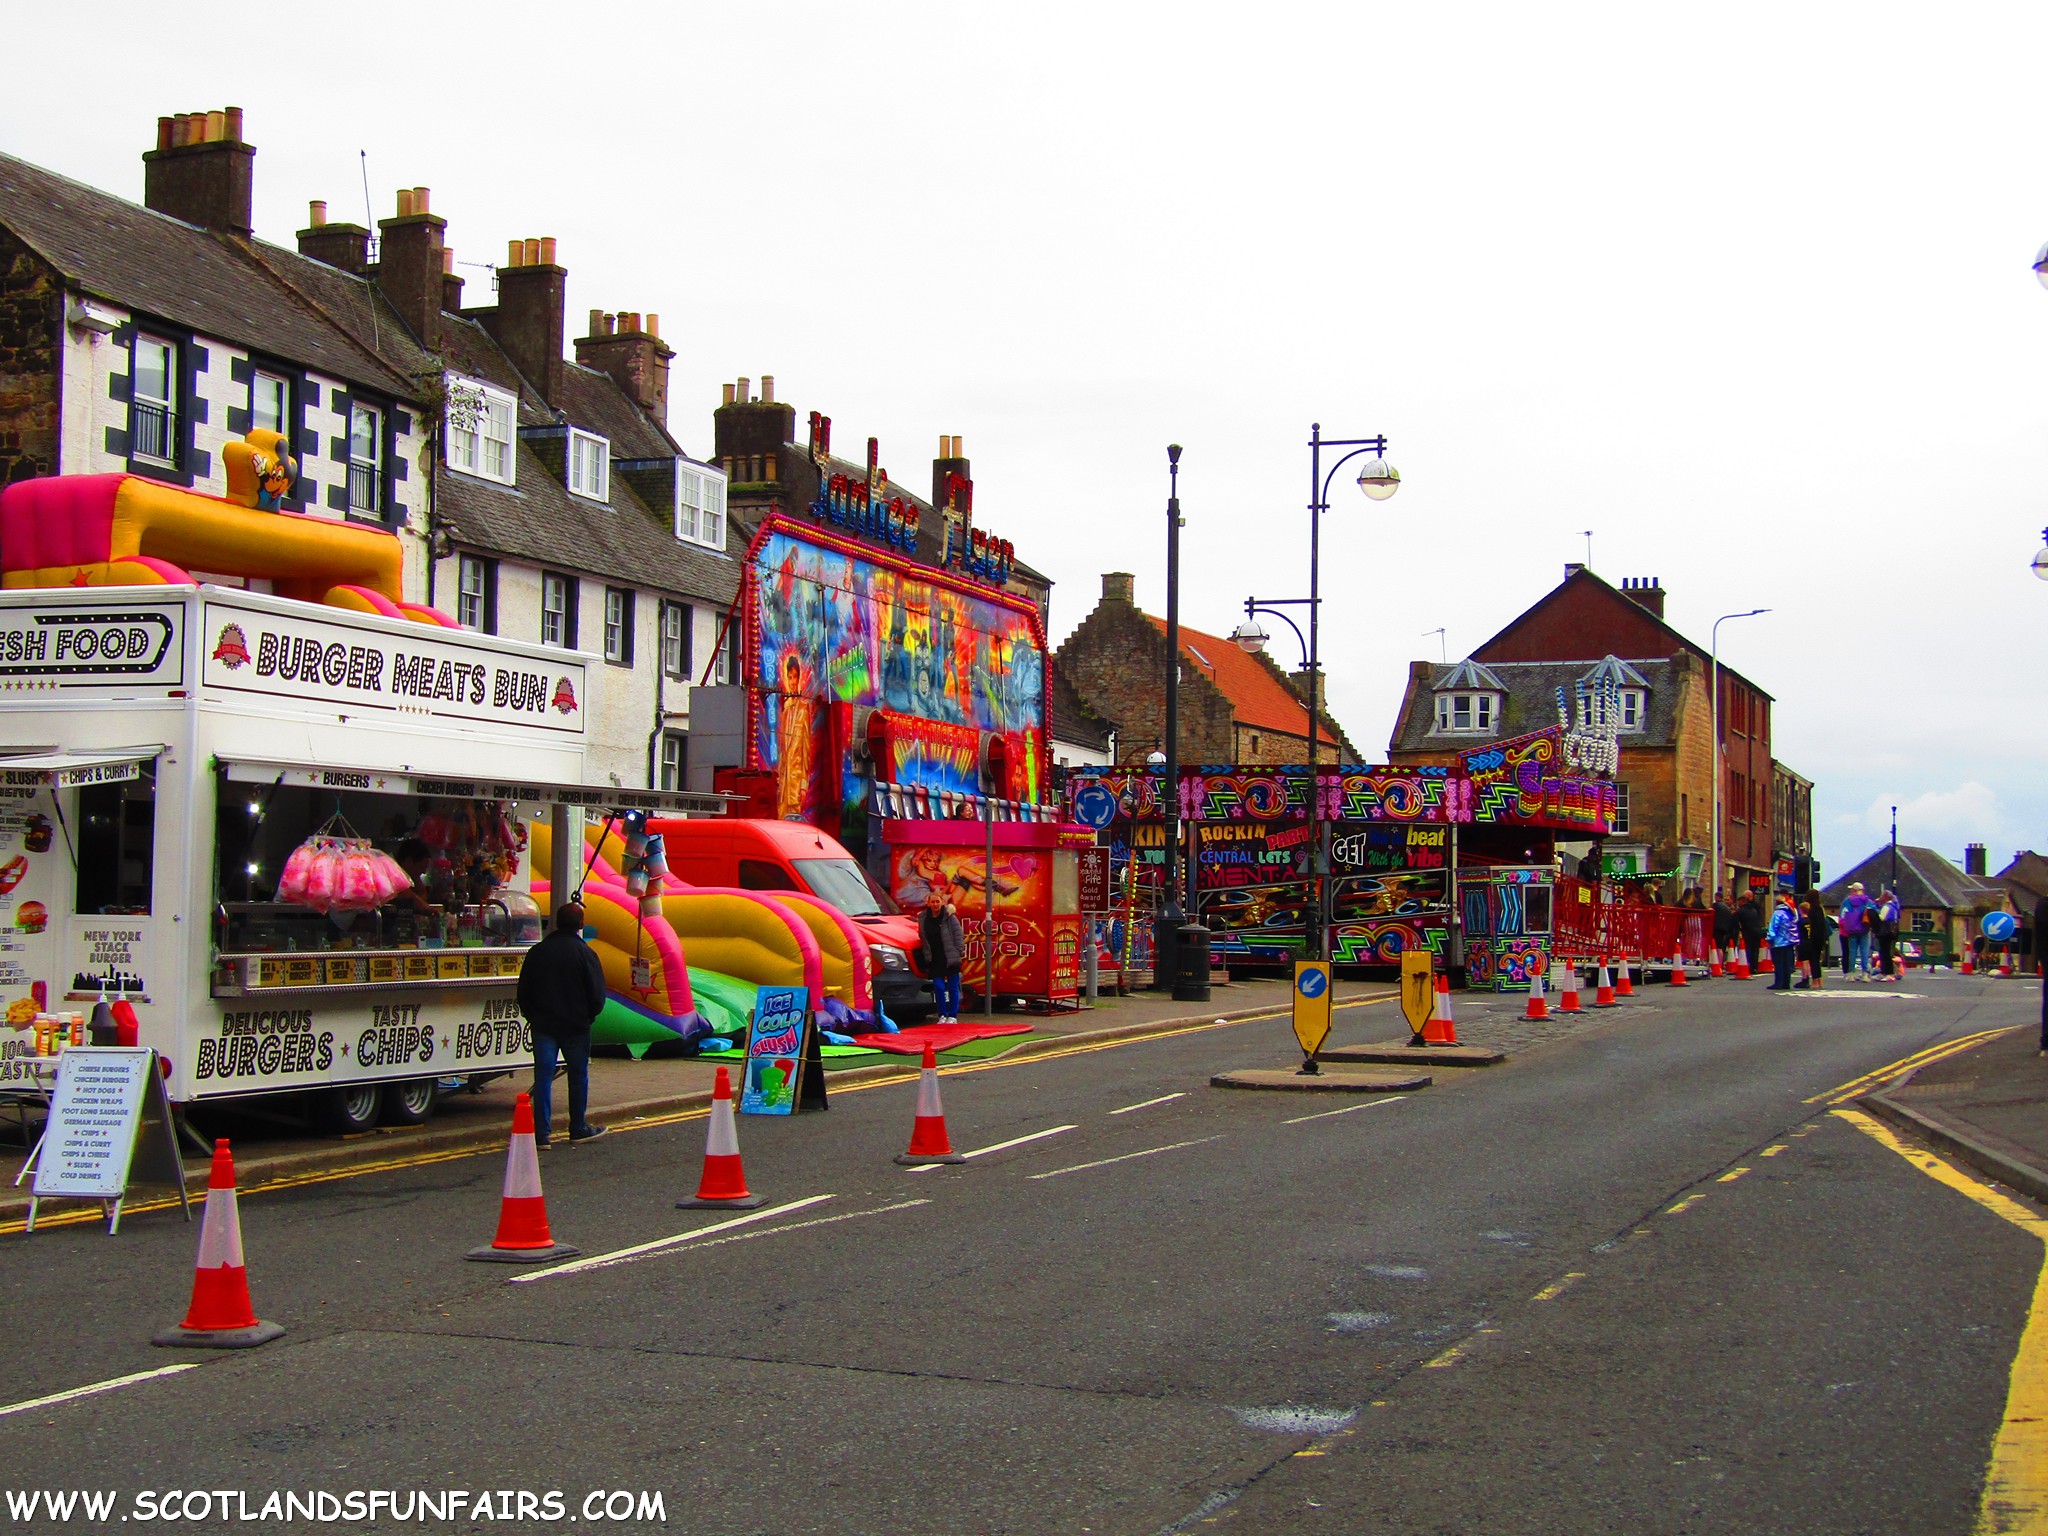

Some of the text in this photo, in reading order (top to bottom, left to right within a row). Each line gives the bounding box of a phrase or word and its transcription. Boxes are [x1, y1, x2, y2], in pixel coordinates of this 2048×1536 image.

[809, 411, 1014, 584] Yankee Flyer
[56, 628, 149, 660] FOOD
[256, 631, 548, 713] BURGER MEATS BUN
[6, 770, 39, 785] SLUSH
[70, 764, 129, 784] CHIPS & CURRY
[323, 771, 370, 788] BURGERS
[416, 780, 475, 797] CHICKEN BURGERS
[493, 785, 511, 799] CHIPS
[1458, 779, 1471, 822] SPIN
[1199, 824, 1266, 842] ROCKIN
[1406, 824, 1445, 846] beat
[1199, 850, 1254, 863] CENTRAL
[1258, 850, 1291, 864] LETS
[1332, 833, 1367, 866] GET
[1407, 846, 1443, 867] vibe
[1082, 886, 1098, 894] Gold
[1750, 875, 1770, 887] CAFE
[84, 930, 142, 942] NEW YORK
[961, 917, 1019, 937] kee
[94, 941, 129, 953] STACK
[89, 952, 132, 964] BURGER
[1056, 967, 1071, 978] RIDE
[481, 999, 520, 1021] AWES
[765, 992, 793, 1013] ICE
[222, 1009, 312, 1036] DELICIOUS
[372, 1003, 421, 1027] TASTY
[758, 1010, 802, 1032] COLD
[357, 1024, 434, 1067] CHIPS
[455, 1020, 534, 1058] HOTDO
[752, 1025, 798, 1057] SLUSH
[196, 1031, 334, 1079] BURGERS
[61, 1150, 79, 1158] CHIPS
[78, 1172, 101, 1180] DRINKS
